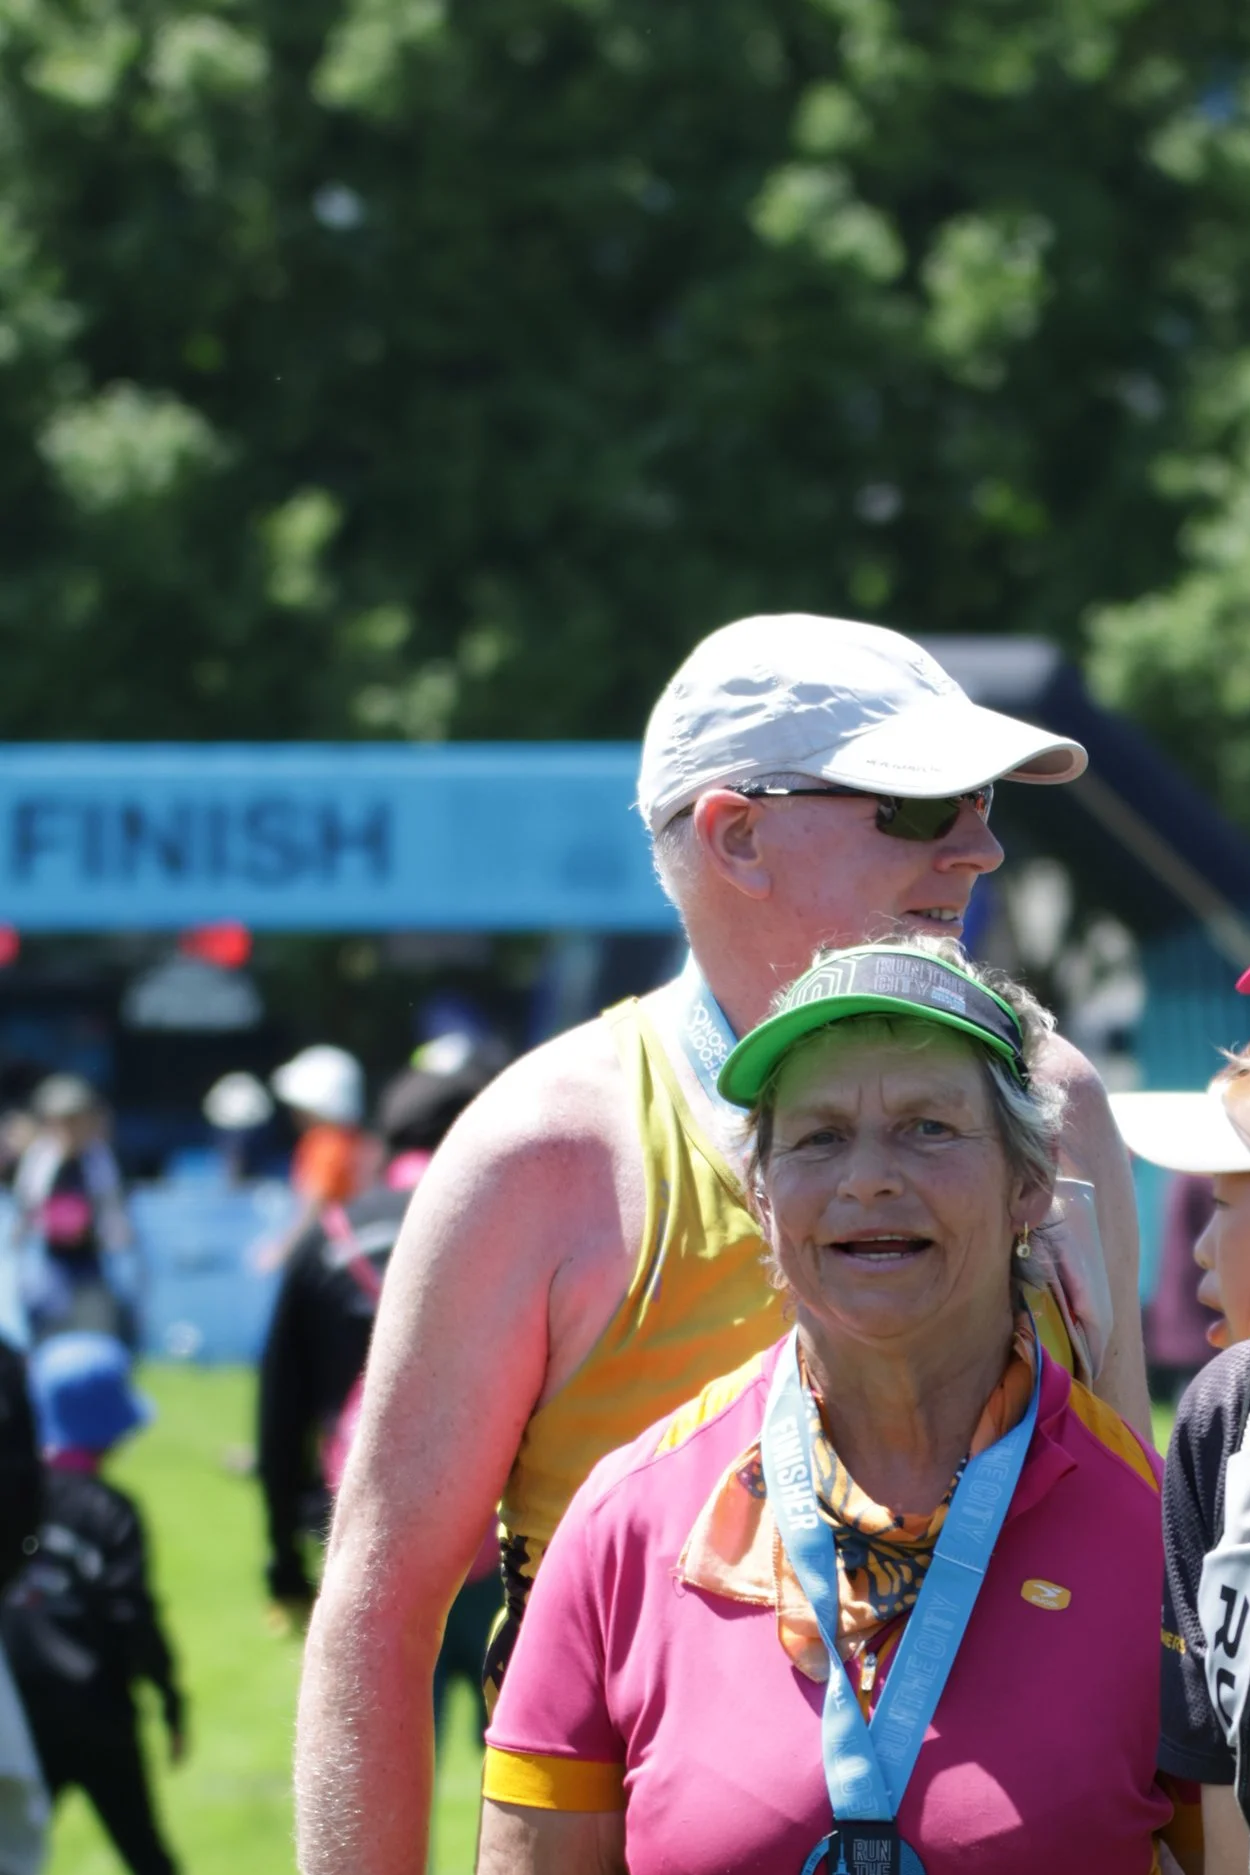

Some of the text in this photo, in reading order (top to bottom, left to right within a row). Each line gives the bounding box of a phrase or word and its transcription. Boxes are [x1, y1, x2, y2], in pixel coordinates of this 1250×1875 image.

[8, 796, 392, 886] FINISH
[876, 957, 924, 981] RUN
[873, 974, 932, 997] CITY
[769, 1414, 819, 1531] FINISHER
[853, 1838, 891, 1862] RUN
